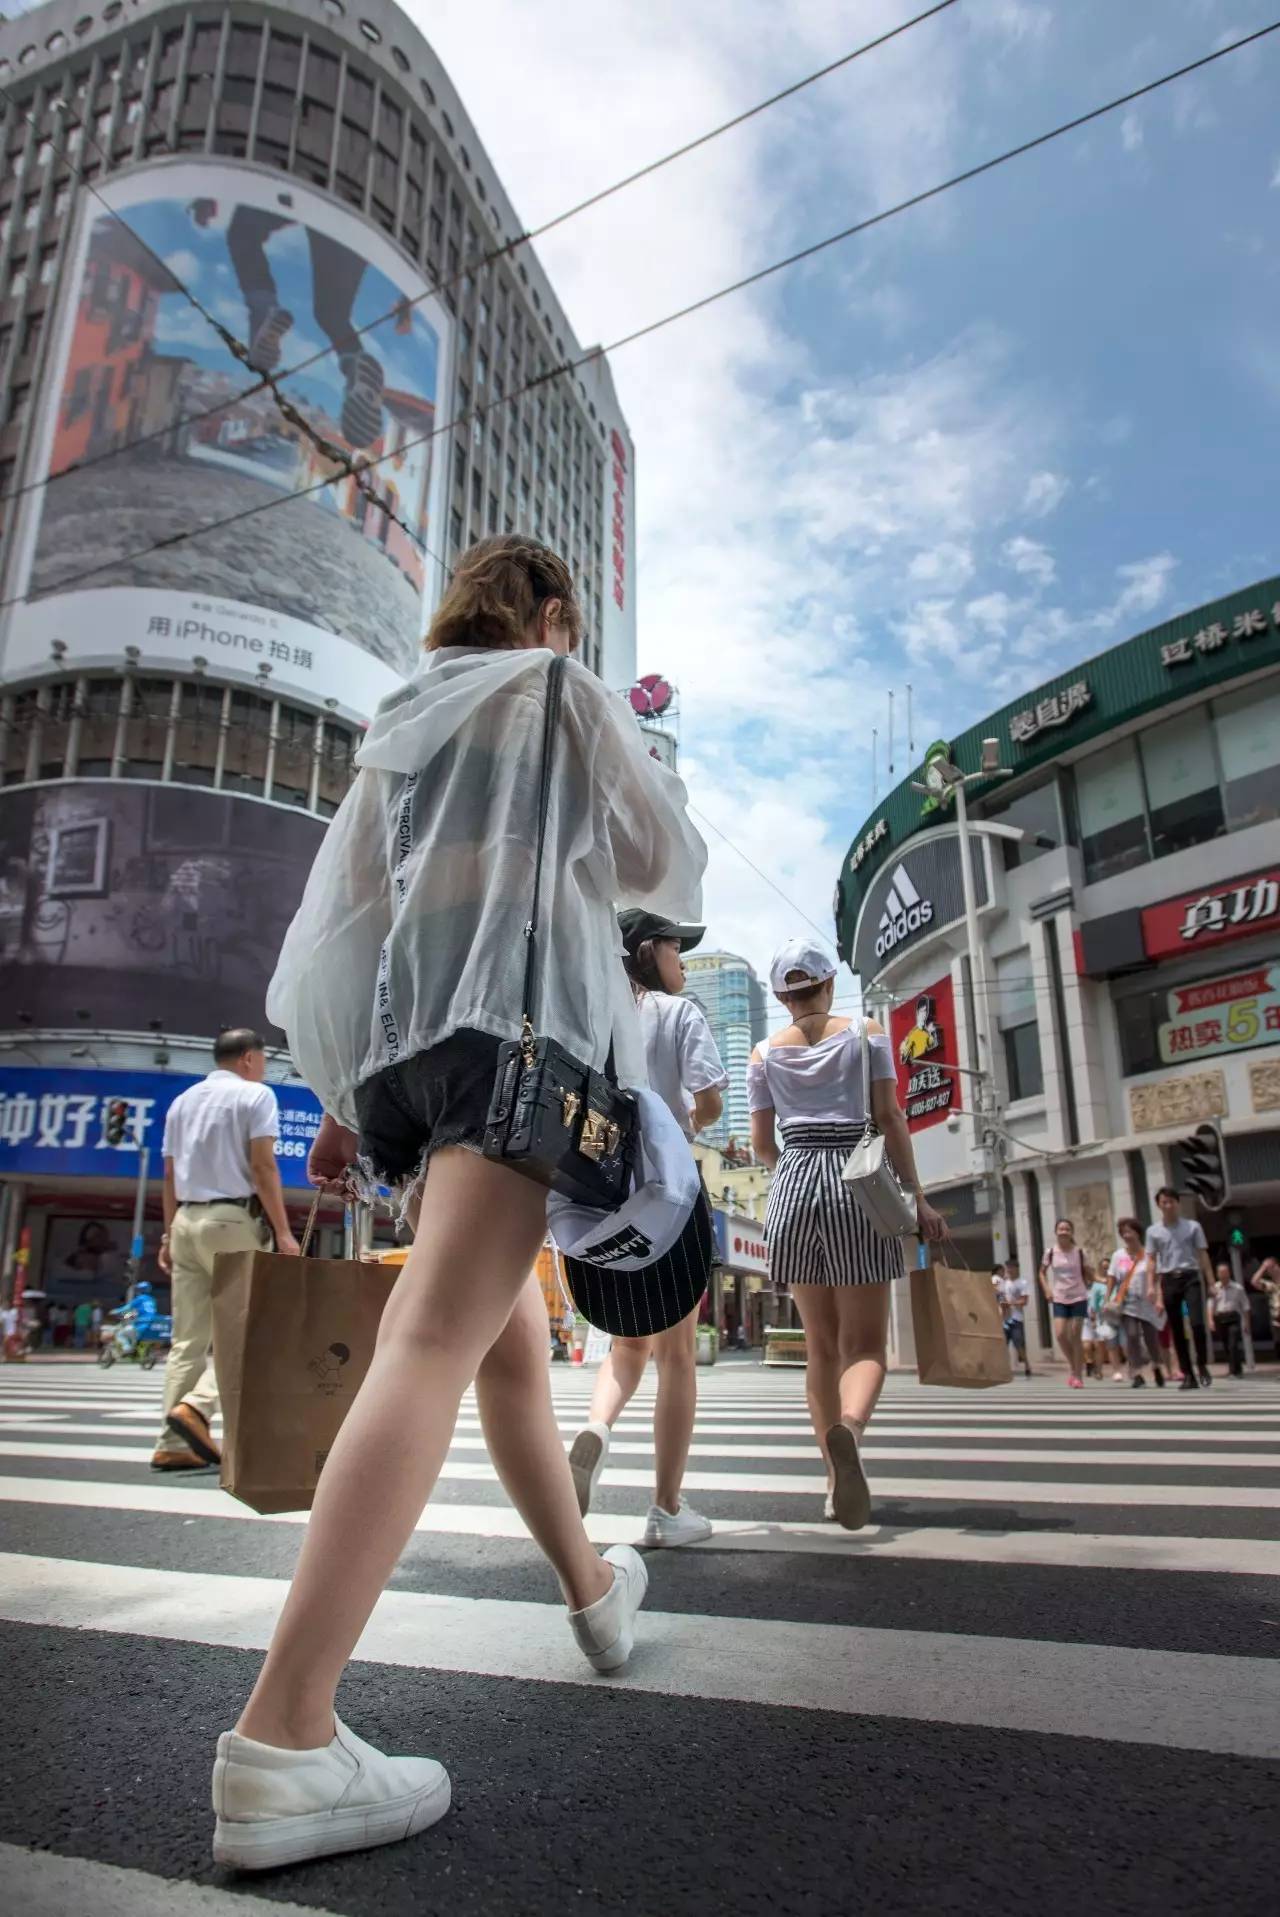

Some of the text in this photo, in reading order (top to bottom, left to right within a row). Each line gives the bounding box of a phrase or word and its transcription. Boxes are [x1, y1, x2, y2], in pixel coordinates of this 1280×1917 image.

[148, 616, 313, 671] 用 iPhone 拍摄
[875, 900, 933, 957] adidas
